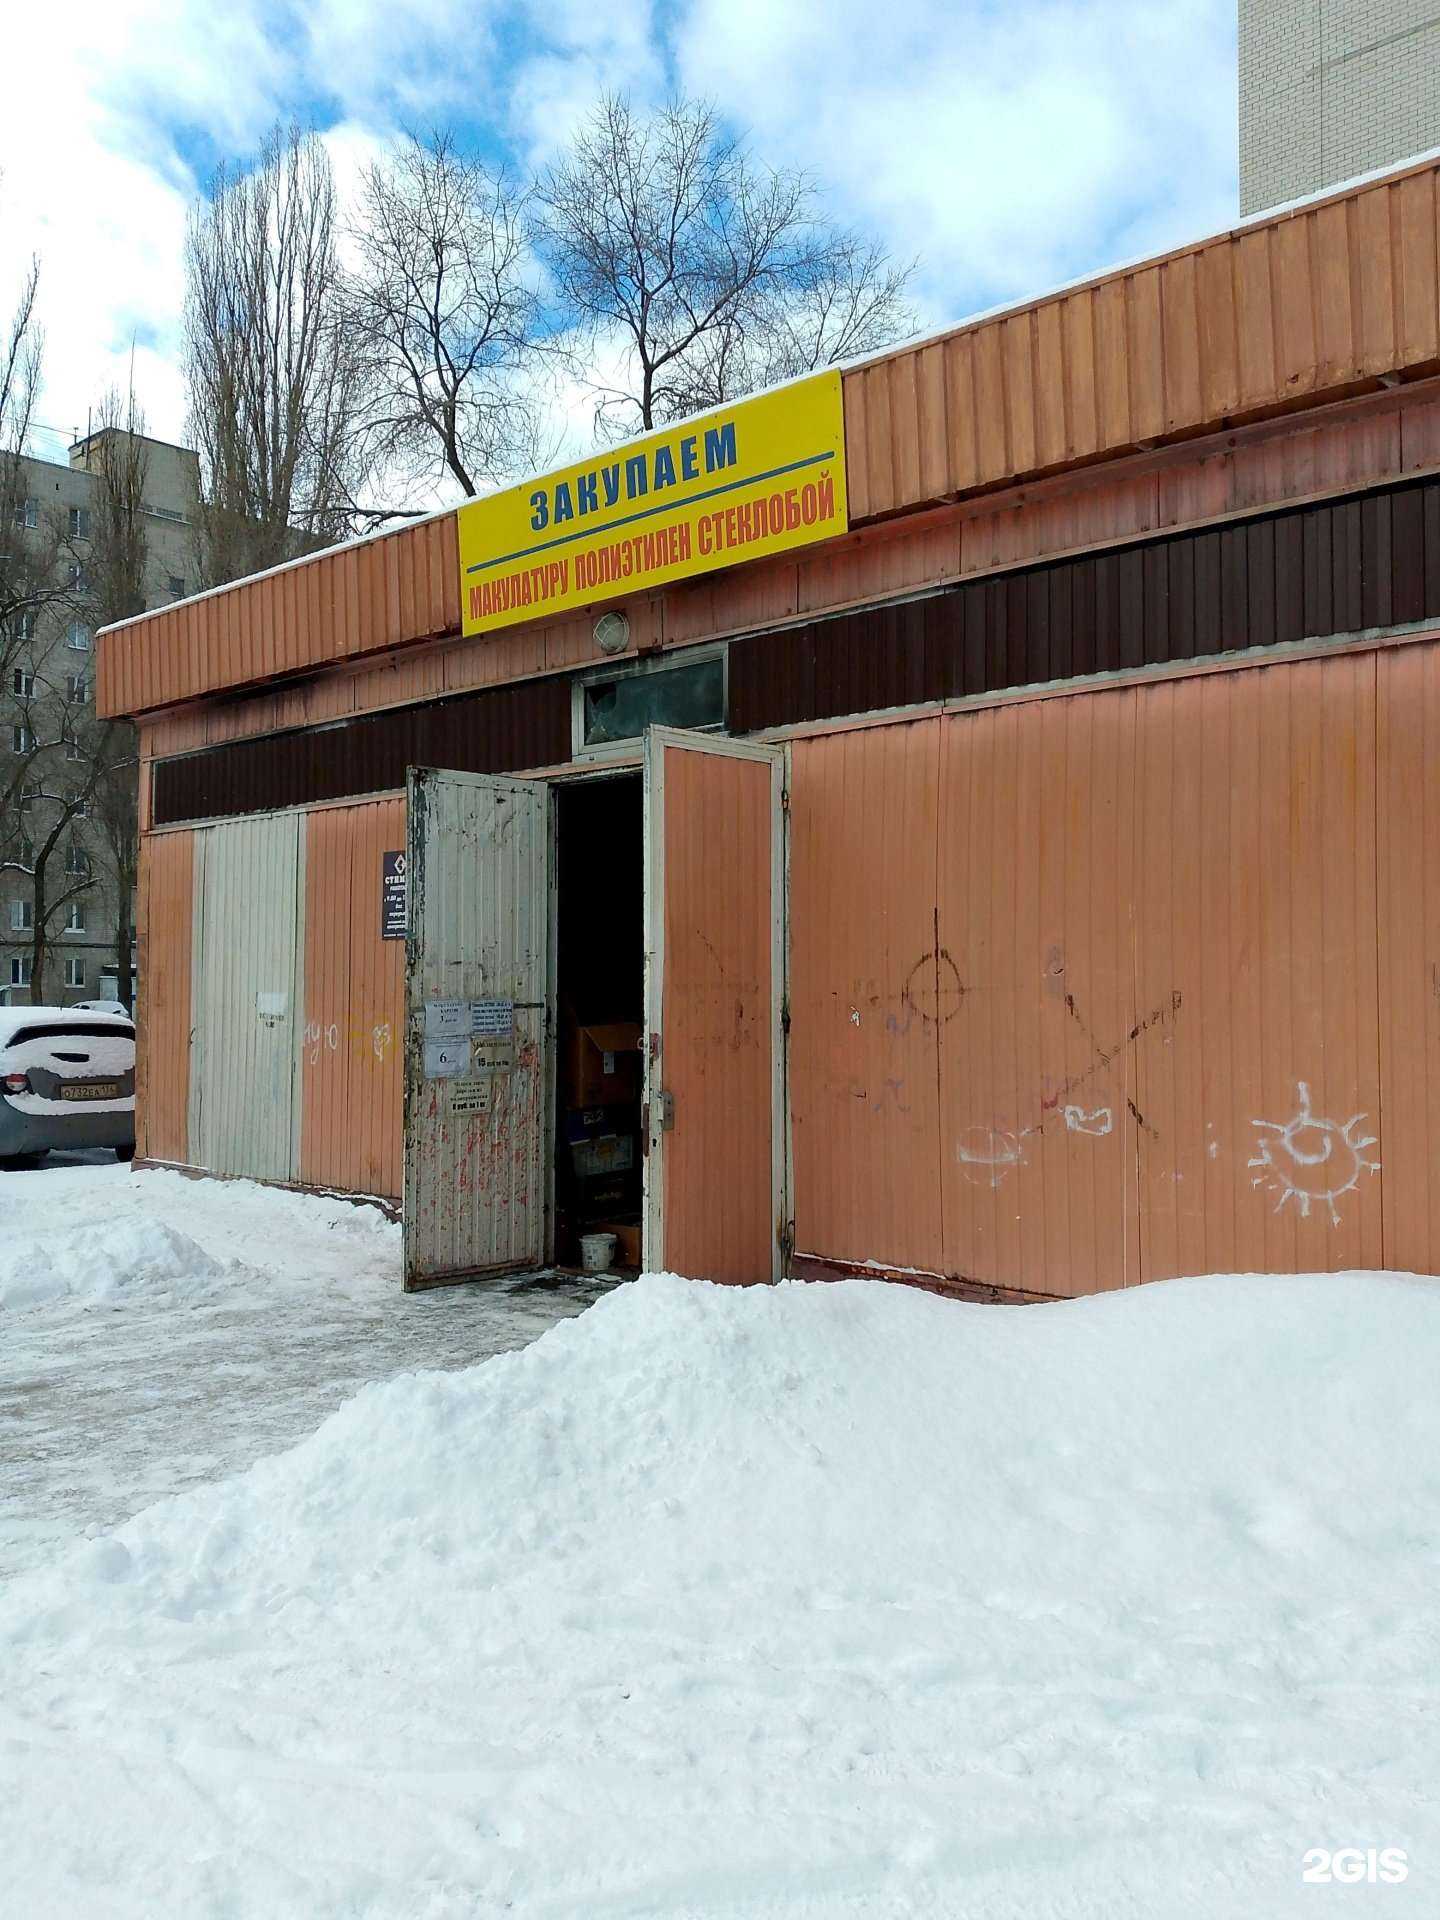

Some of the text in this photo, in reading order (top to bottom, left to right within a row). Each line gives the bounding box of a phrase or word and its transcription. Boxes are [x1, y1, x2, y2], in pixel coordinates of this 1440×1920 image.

[530, 422, 737, 531] ЗАКУПАЕМ
[470, 470, 835, 620] МАКУЛАТУРУ ПОЛИЭТИЛЕН СТЕКЛОБОЙ
